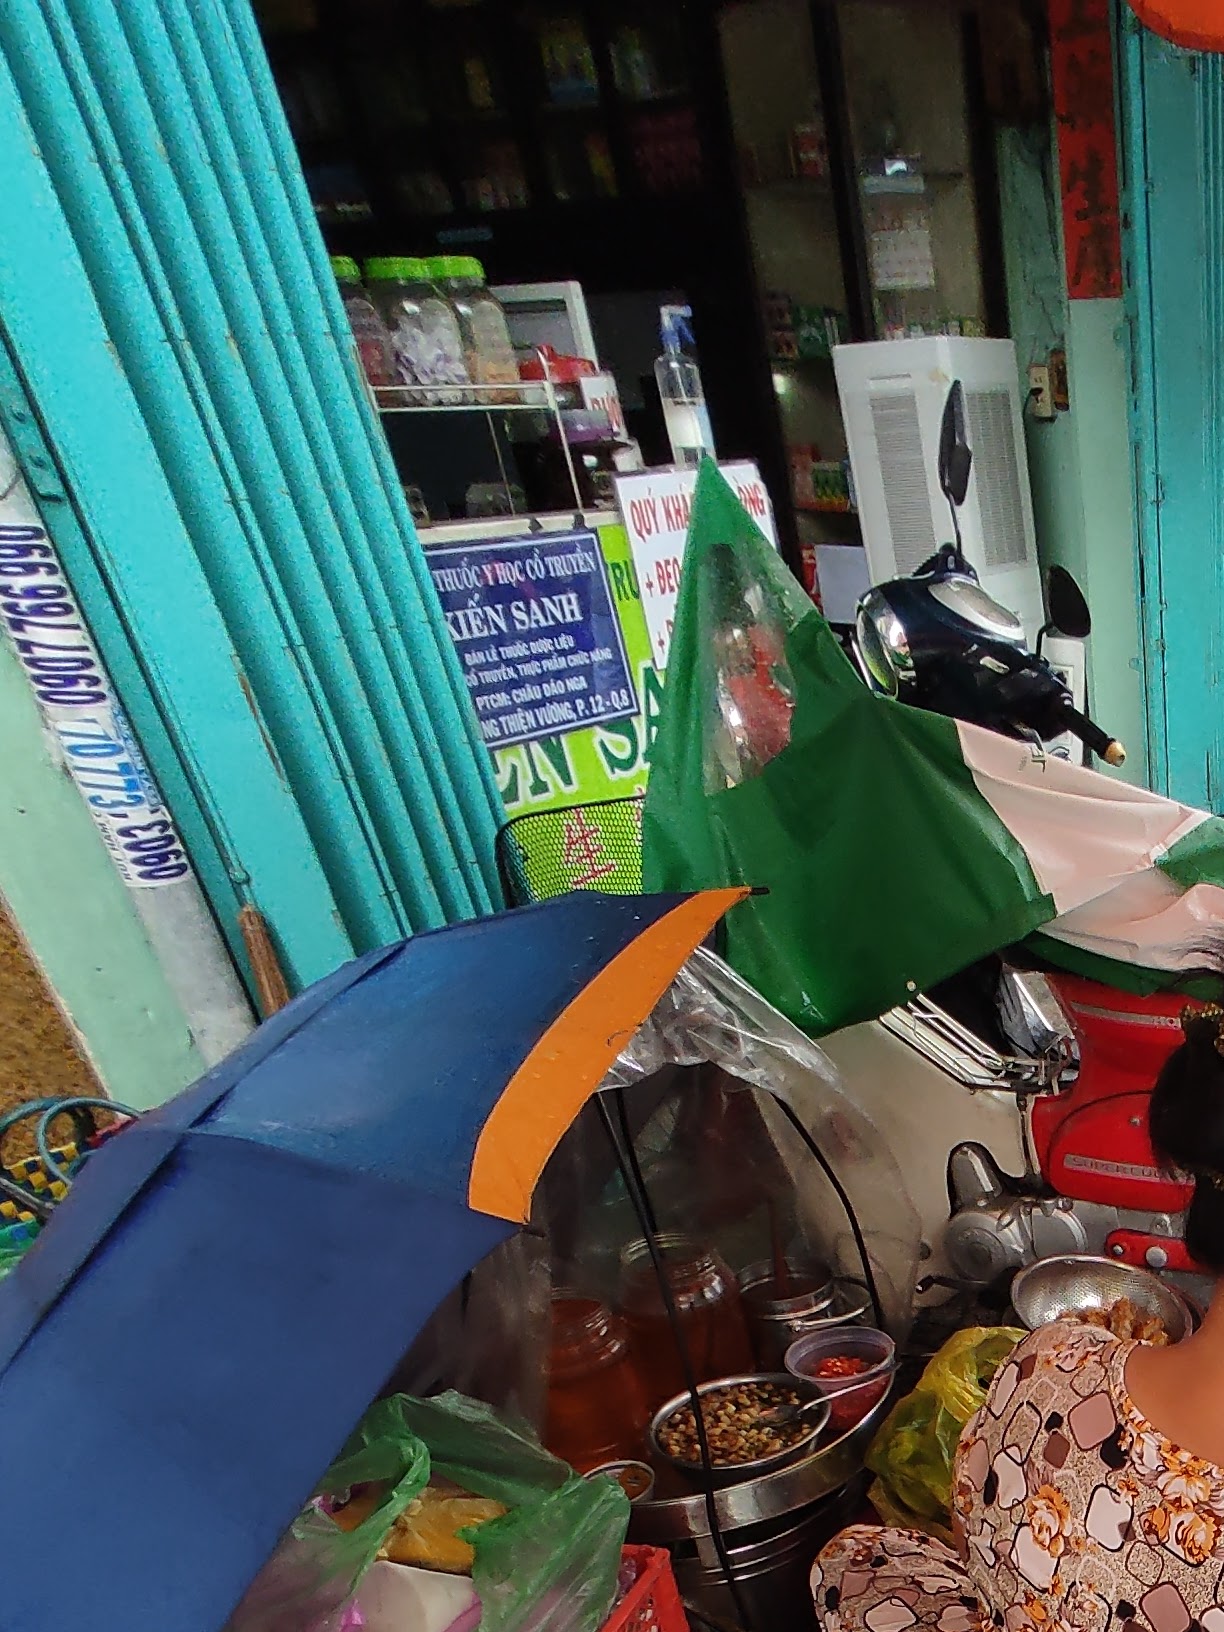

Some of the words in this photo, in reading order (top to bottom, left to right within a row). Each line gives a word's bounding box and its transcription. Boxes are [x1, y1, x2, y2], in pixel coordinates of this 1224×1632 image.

[482, 563, 495, 586] Y
[495, 560, 525, 588] HỌC
[525, 547, 546, 581] CỔ
[510, 592, 584, 632] SANH
[565, 675, 588, 692] NGA
[116, 819, 189, 881] 0903
